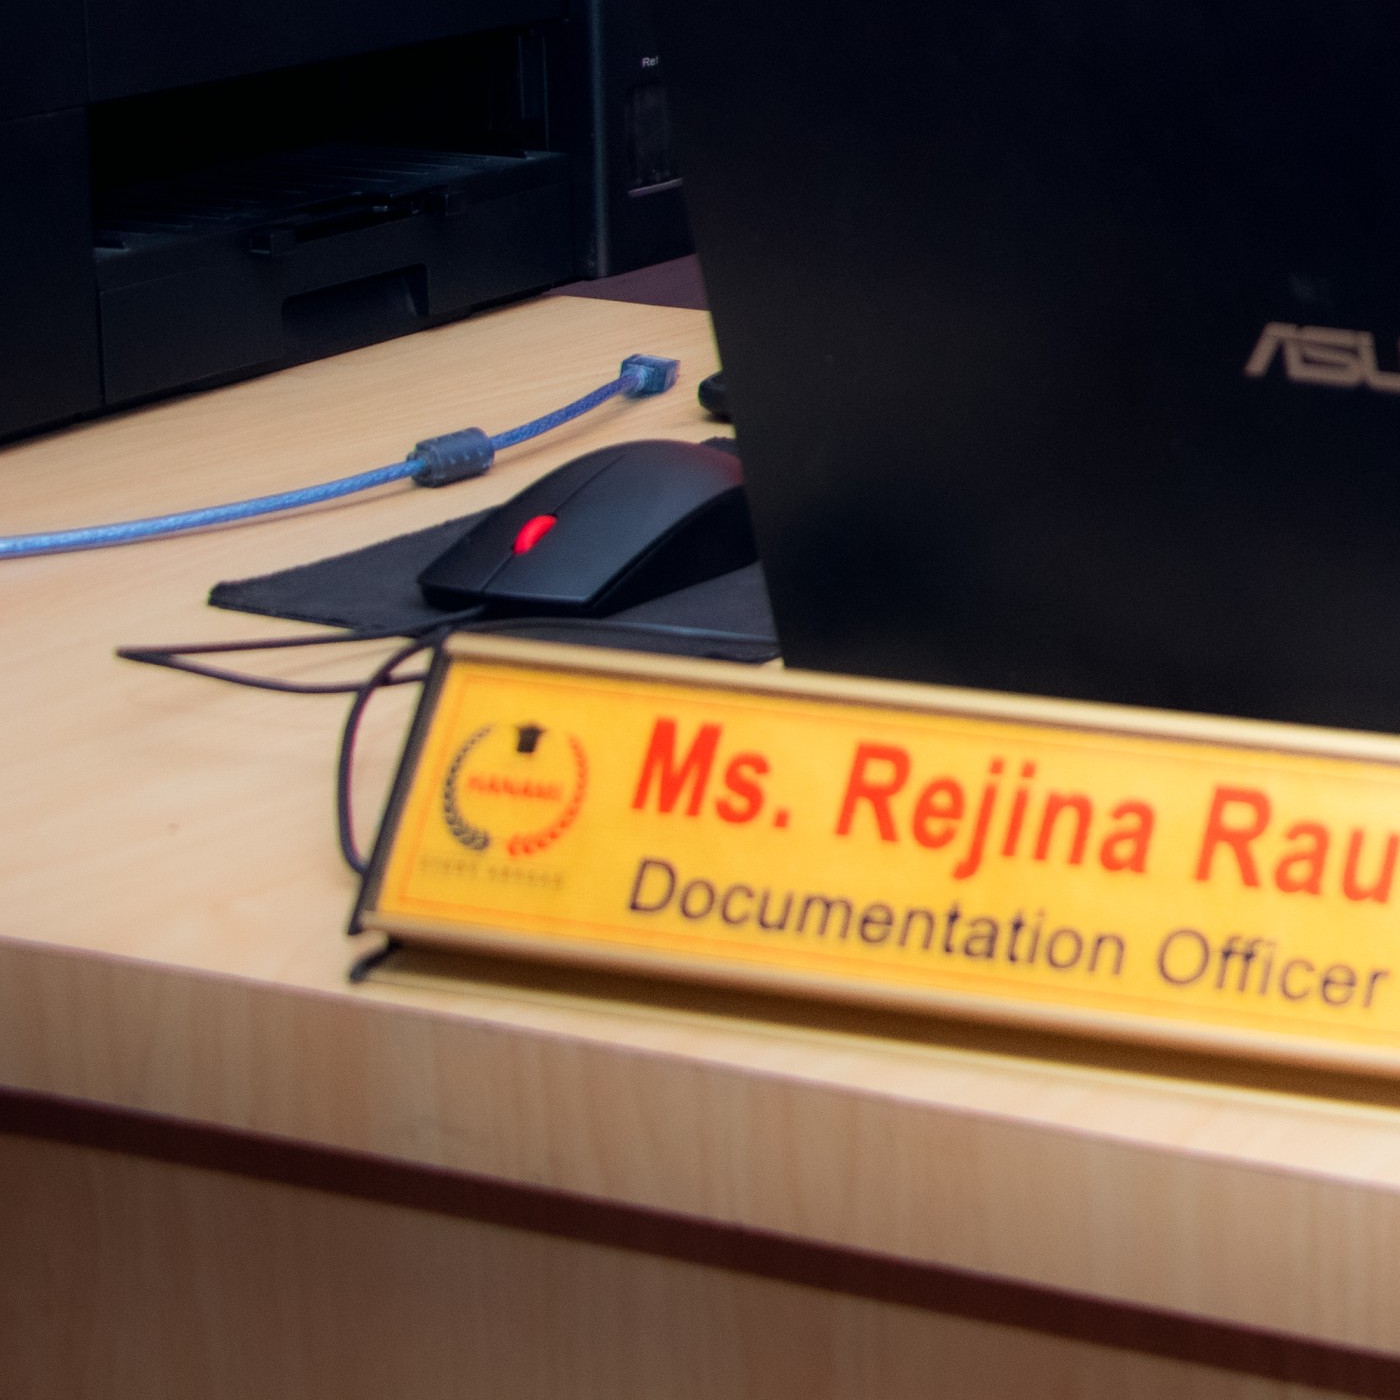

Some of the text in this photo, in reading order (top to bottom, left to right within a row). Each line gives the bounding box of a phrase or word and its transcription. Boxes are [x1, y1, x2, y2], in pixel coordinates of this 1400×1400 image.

[630, 716, 791, 830] Ms.
[834, 740, 1157, 881] Rejina
[628, 855, 1391, 1010] Documentation Officer
